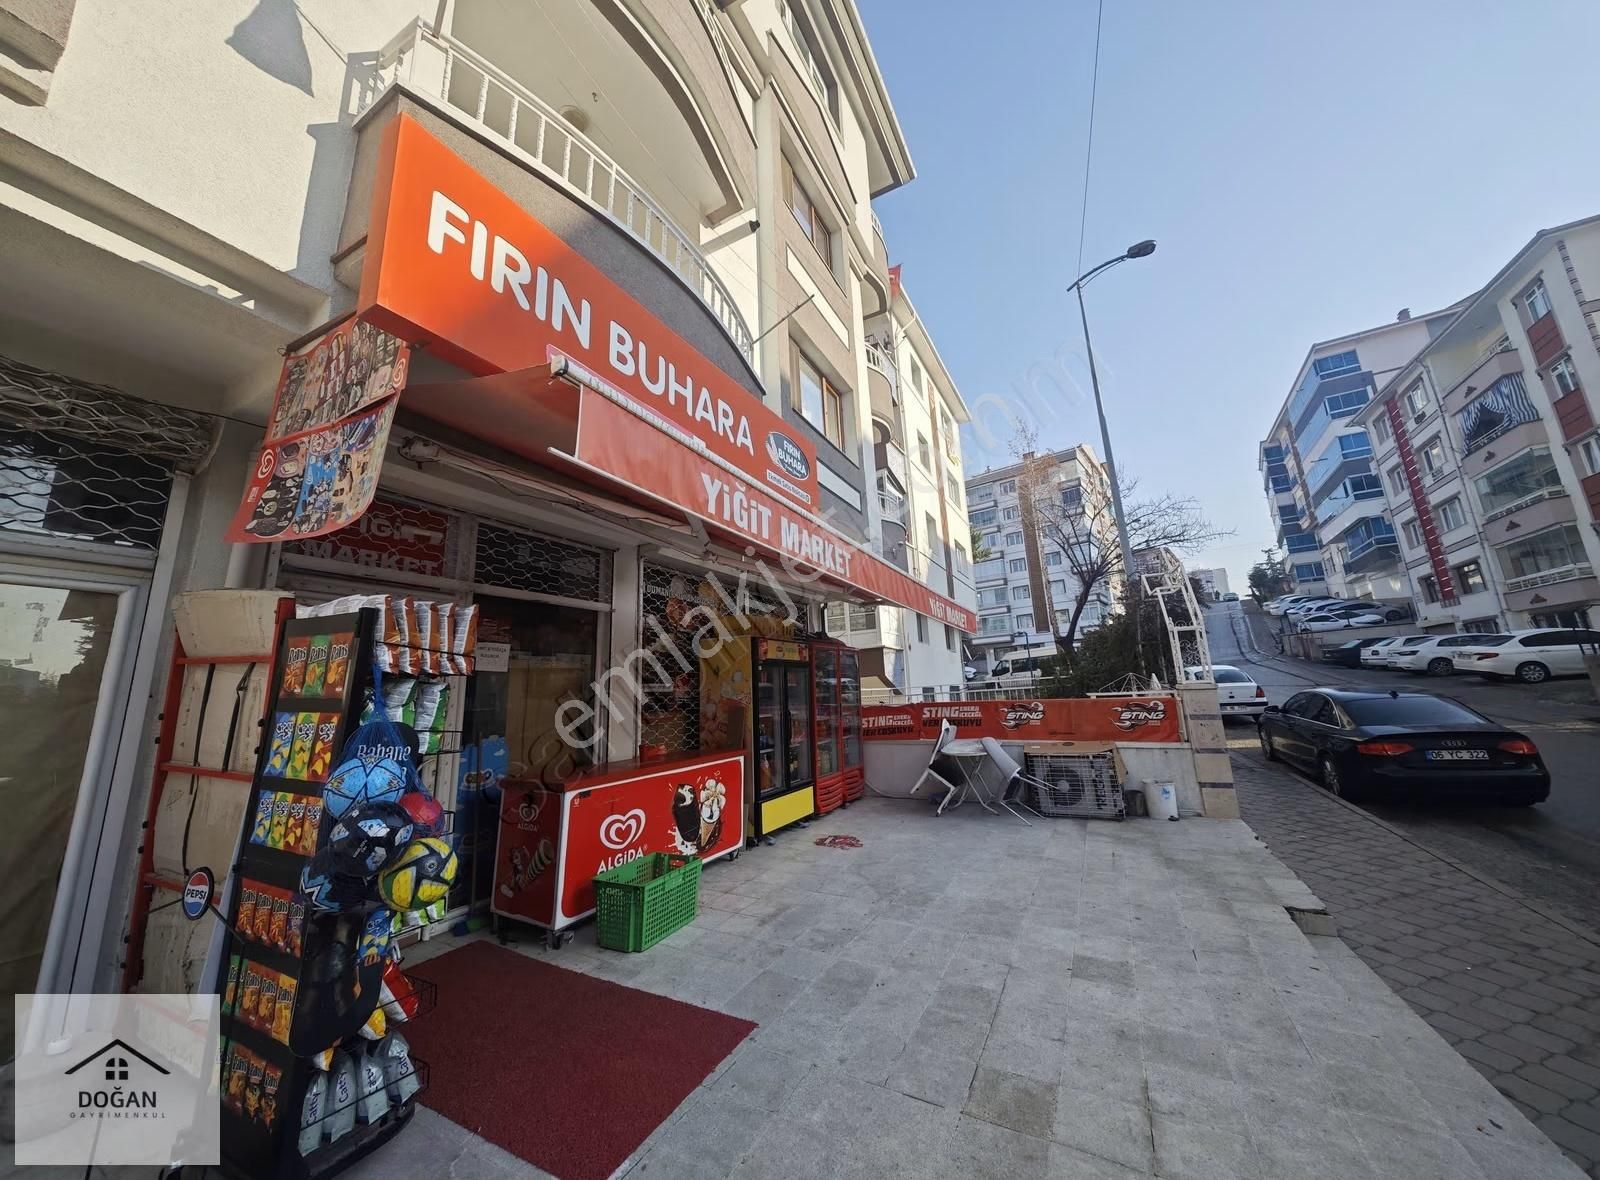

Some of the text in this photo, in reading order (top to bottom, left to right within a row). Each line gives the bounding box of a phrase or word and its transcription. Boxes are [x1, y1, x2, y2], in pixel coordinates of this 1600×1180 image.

[427, 190, 754, 456] FIRIN BUHARA
[783, 440, 801, 460] FIRIN
[778, 447, 807, 476] BUHARA
[780, 516, 851, 577] MARKET
[922, 706, 960, 718] STING
[1006, 711, 1044, 720] STING
[1120, 711, 1165, 720] STING
[862, 715, 894, 728] STING
[186, 888, 206, 900] PEPSI
